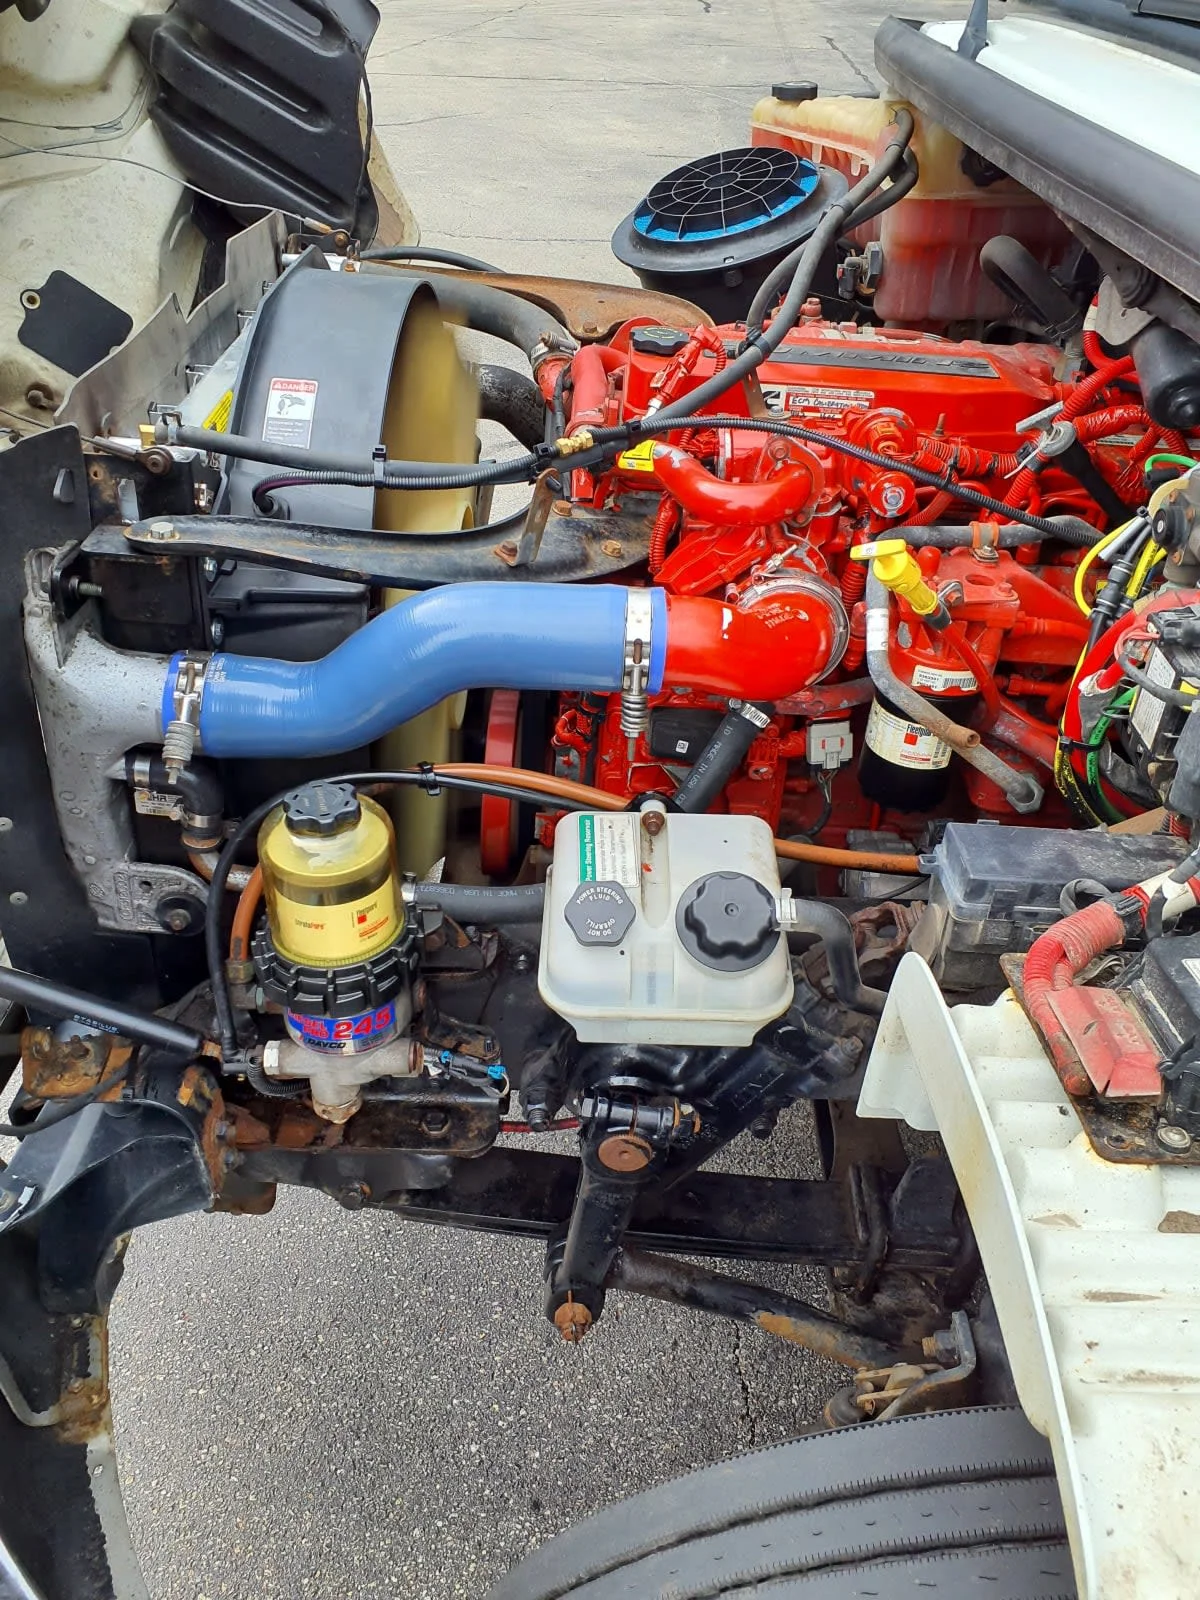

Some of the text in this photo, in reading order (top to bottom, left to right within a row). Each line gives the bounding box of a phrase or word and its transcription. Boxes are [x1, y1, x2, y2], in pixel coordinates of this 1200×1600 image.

[281, 383, 315, 392] DANGER
[791, 397, 809, 406] ECM
[706, 740, 722, 761] MADE
[584, 843, 594, 865] Steering
[584, 866, 593, 882] Power
[576, 886, 624, 905] POWER STEERING
[589, 893, 611, 902] FLUID
[586, 918, 616, 930] OVERFILL
[587, 928, 612, 937] DO NOT
[73, 1014, 118, 1031] STABILUS
[333, 1006, 391, 1040] 245
[307, 1039, 347, 1049] DAVCO
